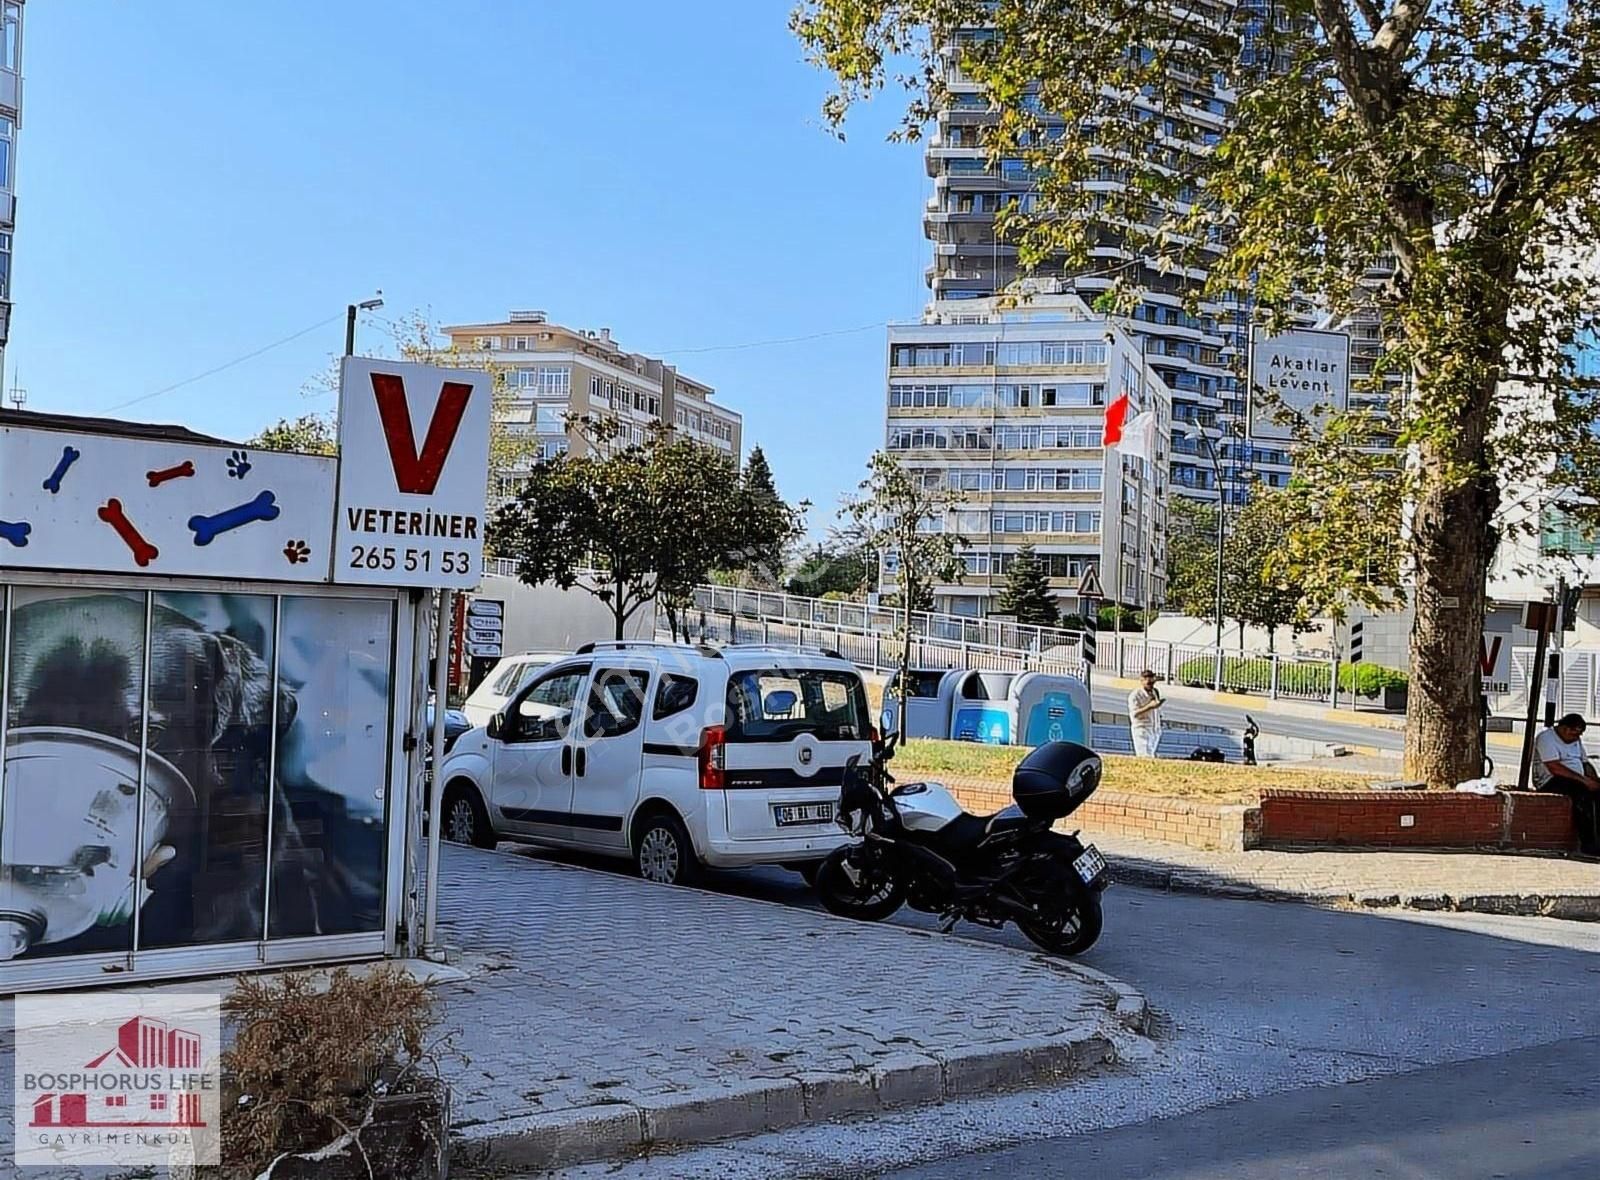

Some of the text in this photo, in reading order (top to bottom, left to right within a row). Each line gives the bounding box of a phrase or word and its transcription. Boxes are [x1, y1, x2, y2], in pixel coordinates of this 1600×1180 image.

[1271, 355, 1337, 372] Akatlar
[1269, 374, 1329, 392] Levent
[370, 372, 474, 496] V
[348, 505, 478, 540] VETERİNER
[350, 546, 470, 575] 265 51 53
